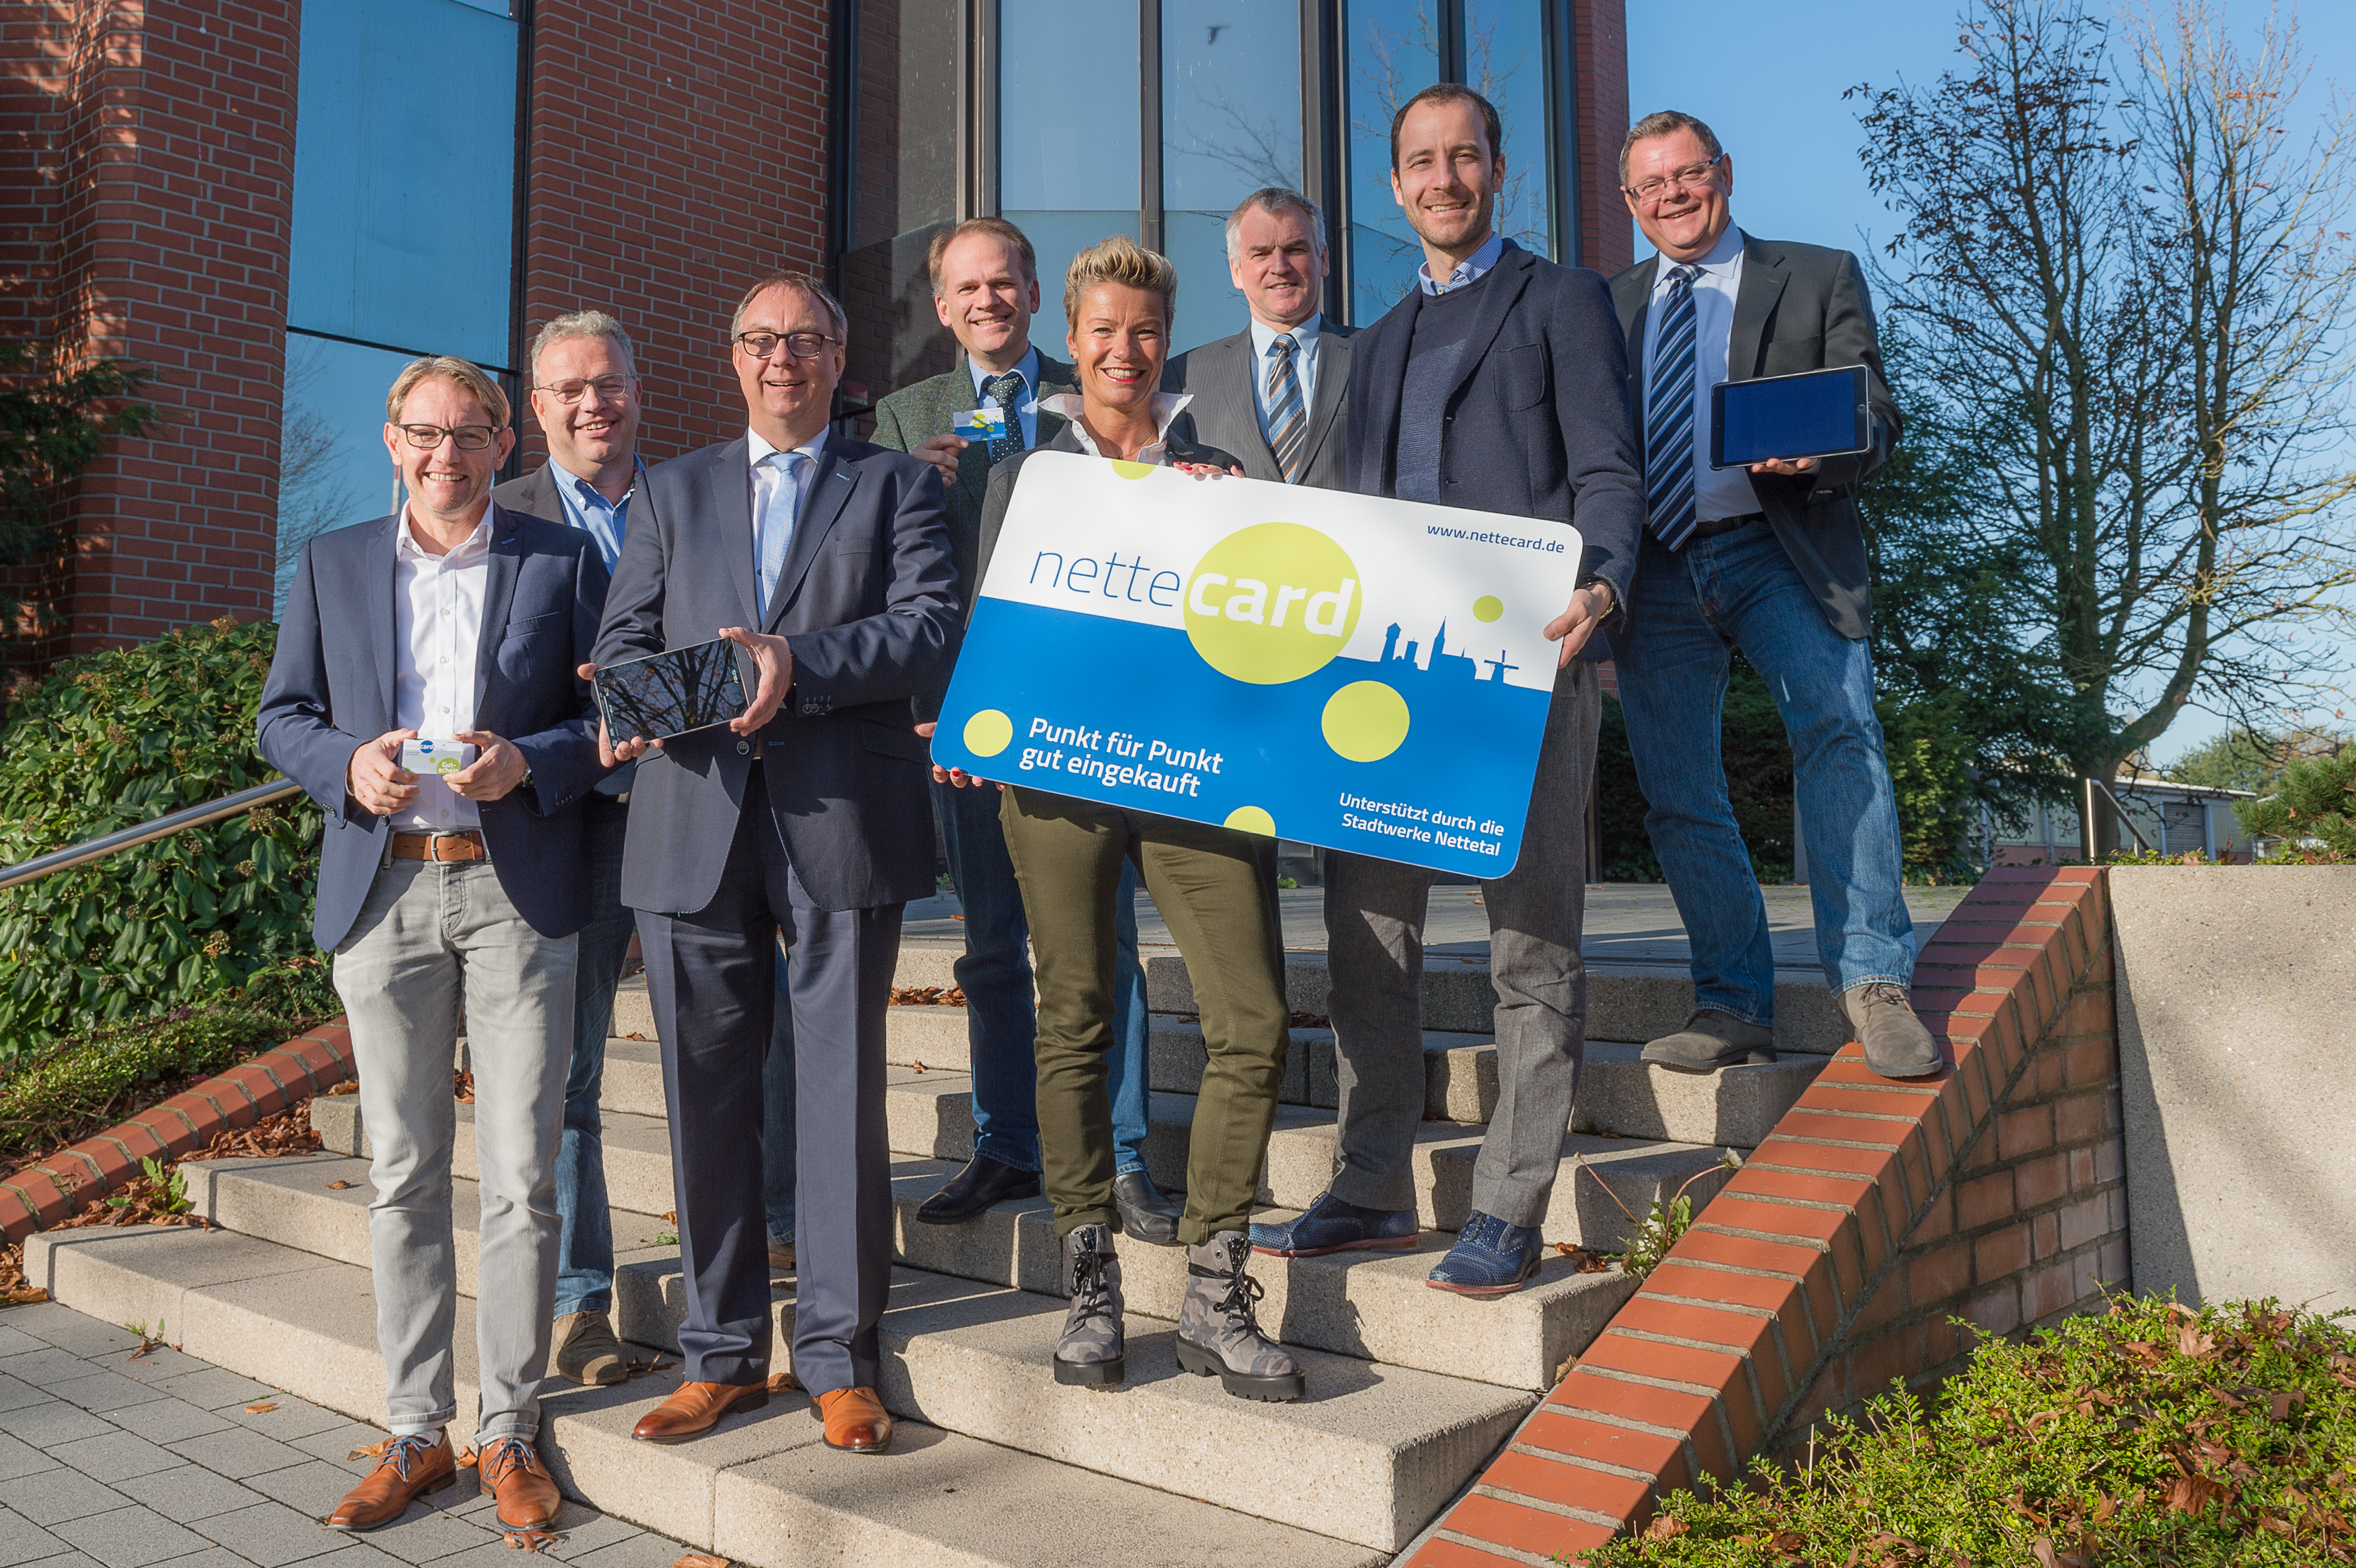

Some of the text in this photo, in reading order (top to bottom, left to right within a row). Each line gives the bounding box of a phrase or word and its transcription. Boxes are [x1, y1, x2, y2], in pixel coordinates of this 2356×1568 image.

[1428, 525, 1564, 553] www.nettecard.de
[1029, 717, 1223, 774] Punkt für Punkt
[1019, 747, 1201, 797] gut eingekauft
[1339, 792, 1505, 836] Unterstützt durch die
[1341, 813, 1501, 856] Stadtwerke Nettetal
